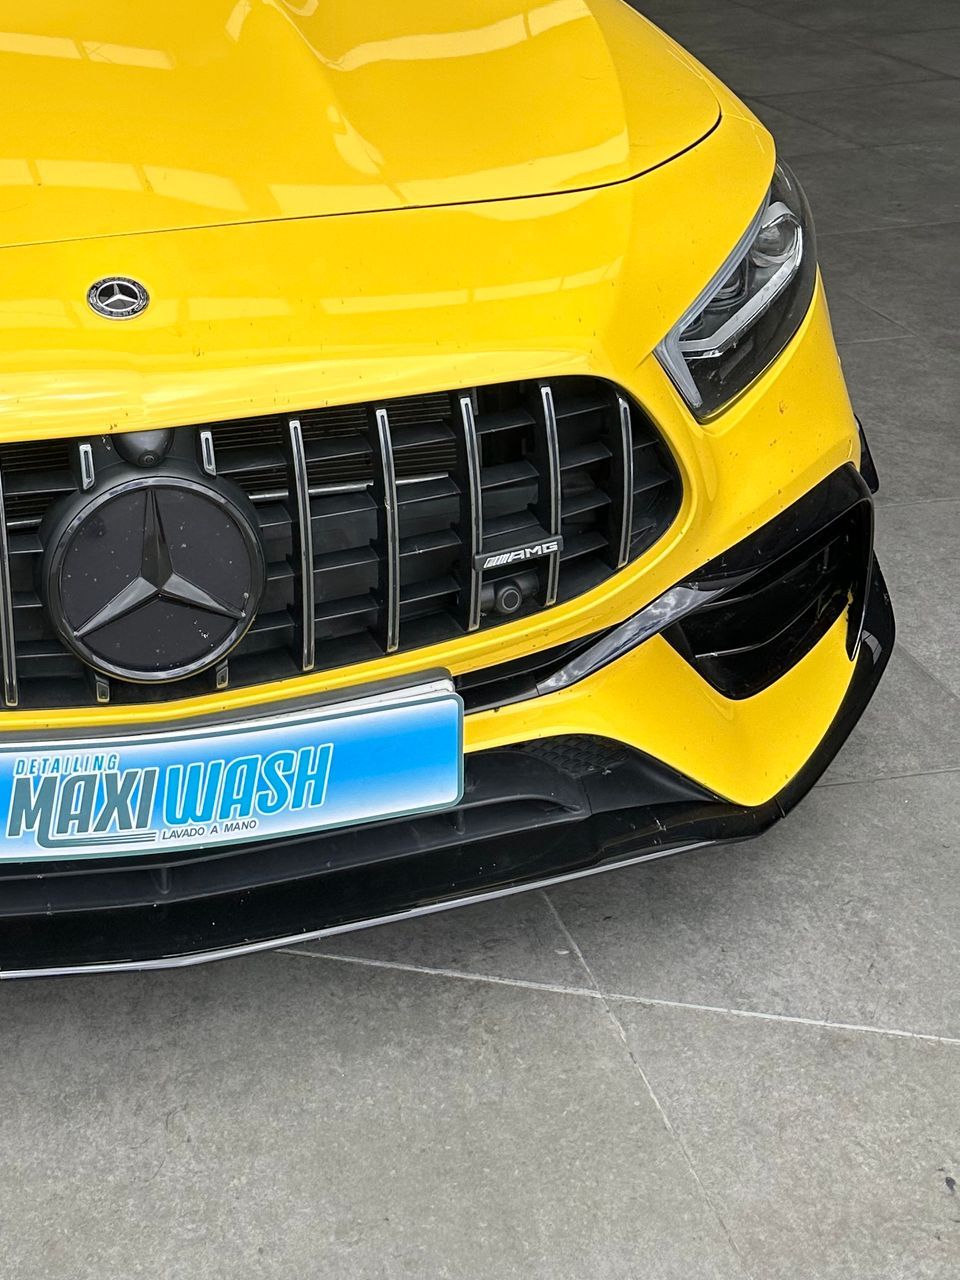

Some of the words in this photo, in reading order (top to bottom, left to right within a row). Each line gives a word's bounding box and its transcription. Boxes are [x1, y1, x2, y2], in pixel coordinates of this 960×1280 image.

[508, 541, 557, 563] AMG
[15, 754, 118, 775] DETAILING
[7, 768, 158, 847] MAXI
[162, 743, 334, 825] WASH
[162, 826, 205, 840] LAVADO
[210, 824, 219, 835] A
[224, 819, 257, 832] MANO
